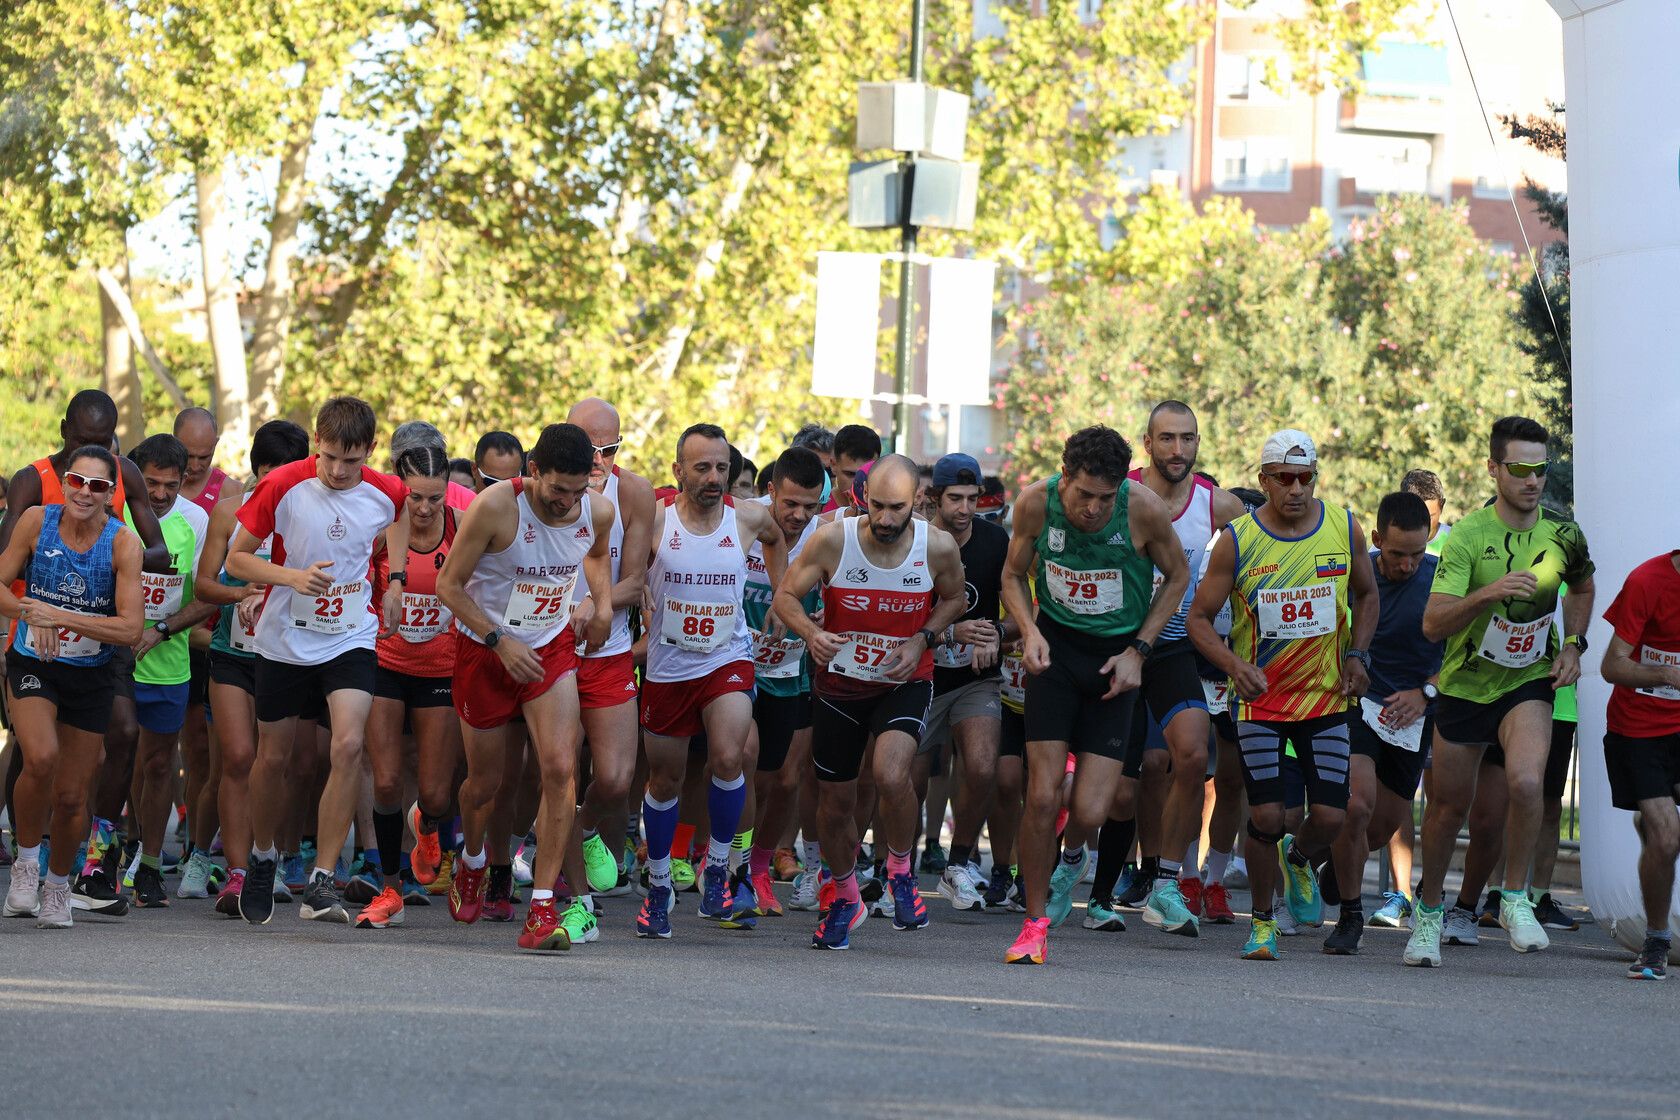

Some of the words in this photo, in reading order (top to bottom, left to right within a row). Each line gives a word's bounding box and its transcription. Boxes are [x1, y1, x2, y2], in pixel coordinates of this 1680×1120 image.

[1048, 563, 1062, 576] 10K
[1064, 570, 1092, 582] PILAR
[1094, 571, 1118, 581] 2023
[1248, 564, 1279, 577] ECUADOR
[141, 574, 164, 586] PILAR
[166, 578, 182, 587] 2023
[342, 582, 361, 595] 2023
[30, 584, 70, 602] Carboneras
[72, 596, 90, 606] sabe
[516, 583, 535, 595] 10K
[536, 584, 564, 596] PILAR
[1066, 581, 1098, 599] 79
[1260, 592, 1278, 604] 10K
[1280, 589, 1308, 602] PILAR
[1310, 586, 1332, 598] 2023
[314, 598, 344, 617] 23
[404, 596, 430, 608] PILAR
[533, 596, 562, 614] 75
[667, 600, 682, 614] 10K
[684, 604, 712, 616] PILAR
[714, 605, 734, 616] 2023
[400, 608, 440, 626] 122
[1282, 601, 1314, 622] 84
[316, 616, 340, 624] SAMUEL
[682, 616, 715, 636] 86
[1494, 620, 1510, 632] 10K
[1510, 624, 1536, 636] PILAR
[684, 636, 710, 644] CARLOS
[856, 634, 884, 648] PILAR
[1506, 635, 1534, 653] 58
[754, 648, 786, 664] 28
[854, 644, 886, 667] 57
[1644, 650, 1662, 662] 10K
[1664, 655, 1680, 665] PIL
[856, 664, 879, 673] JORGE
